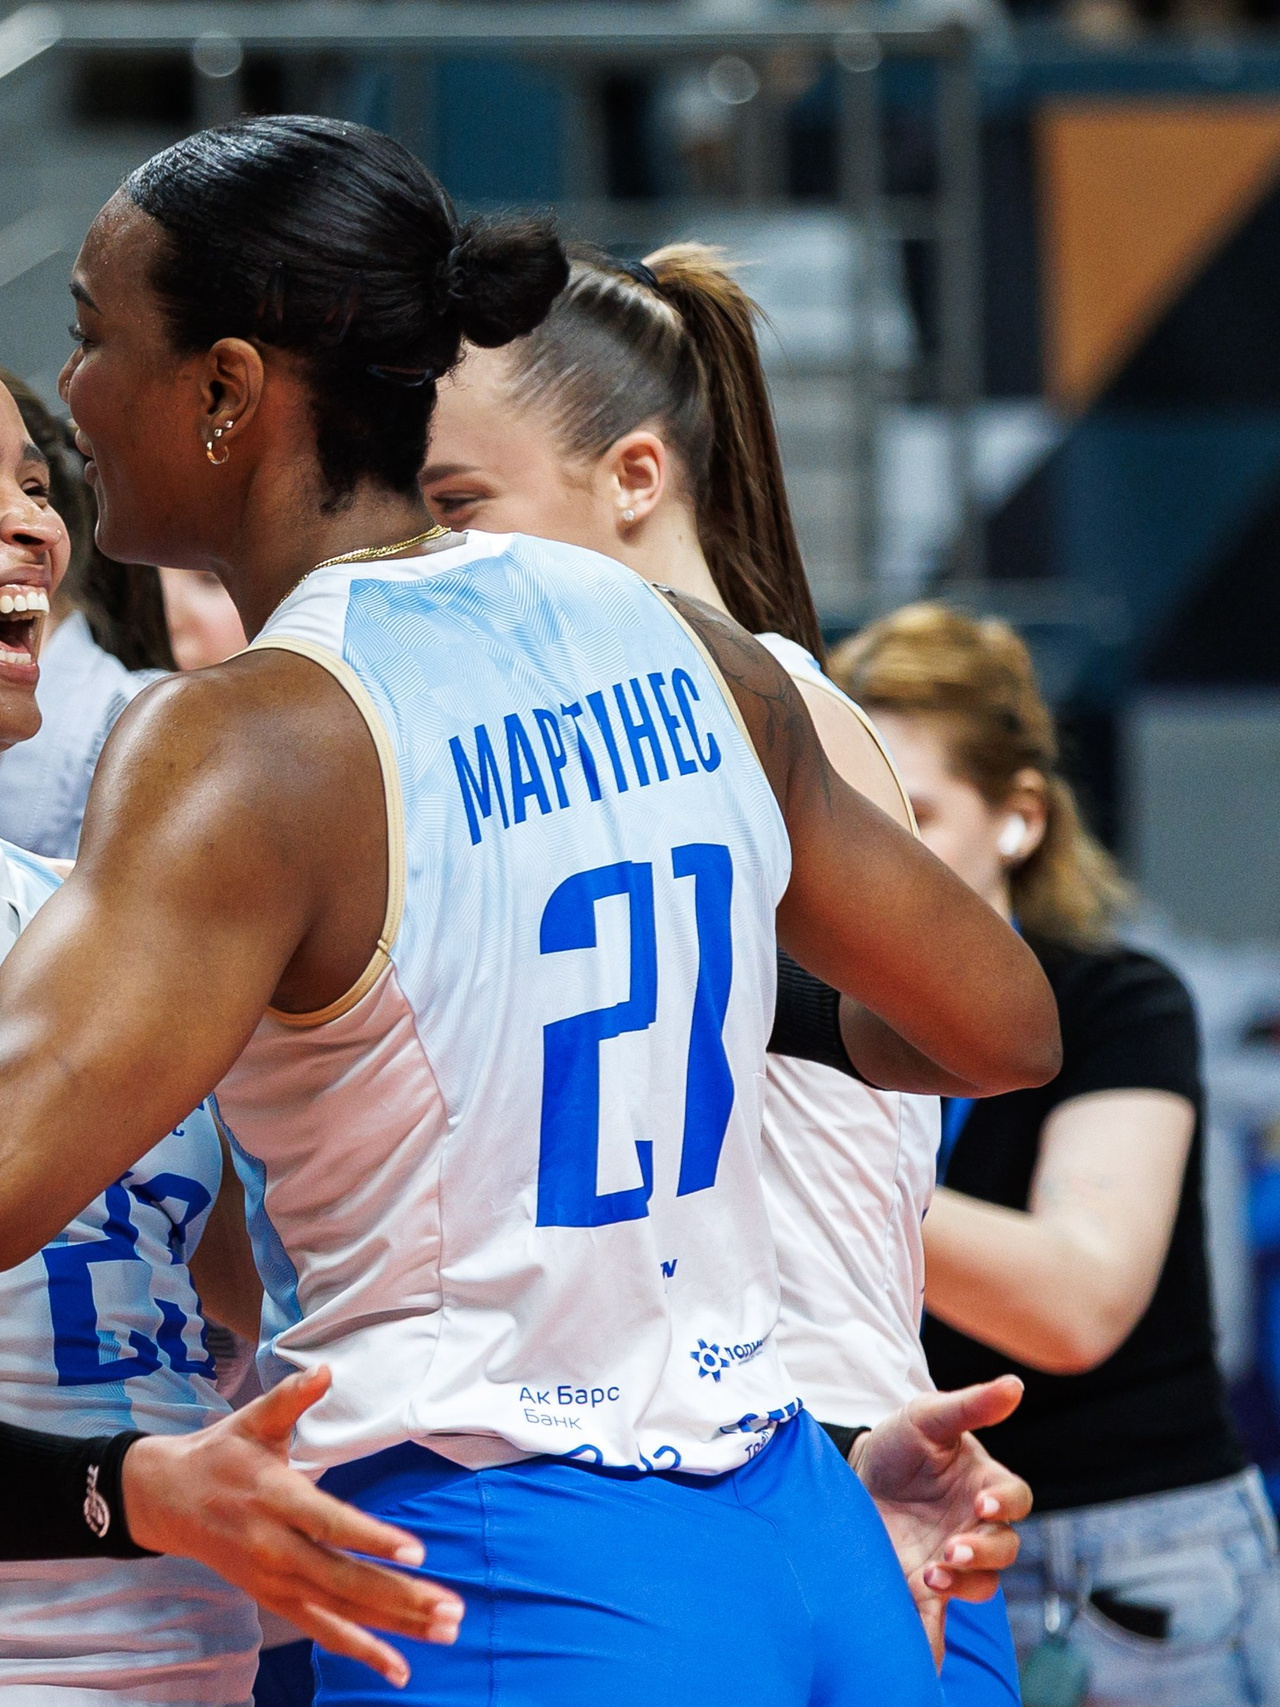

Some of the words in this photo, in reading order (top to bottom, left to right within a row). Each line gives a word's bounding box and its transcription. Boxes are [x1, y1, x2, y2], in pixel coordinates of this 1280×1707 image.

[535, 842, 735, 1229] 21
[519, 1387, 551, 1405] Ак
[557, 1385, 620, 1408] Барс
[523, 1408, 583, 1430] Банк
